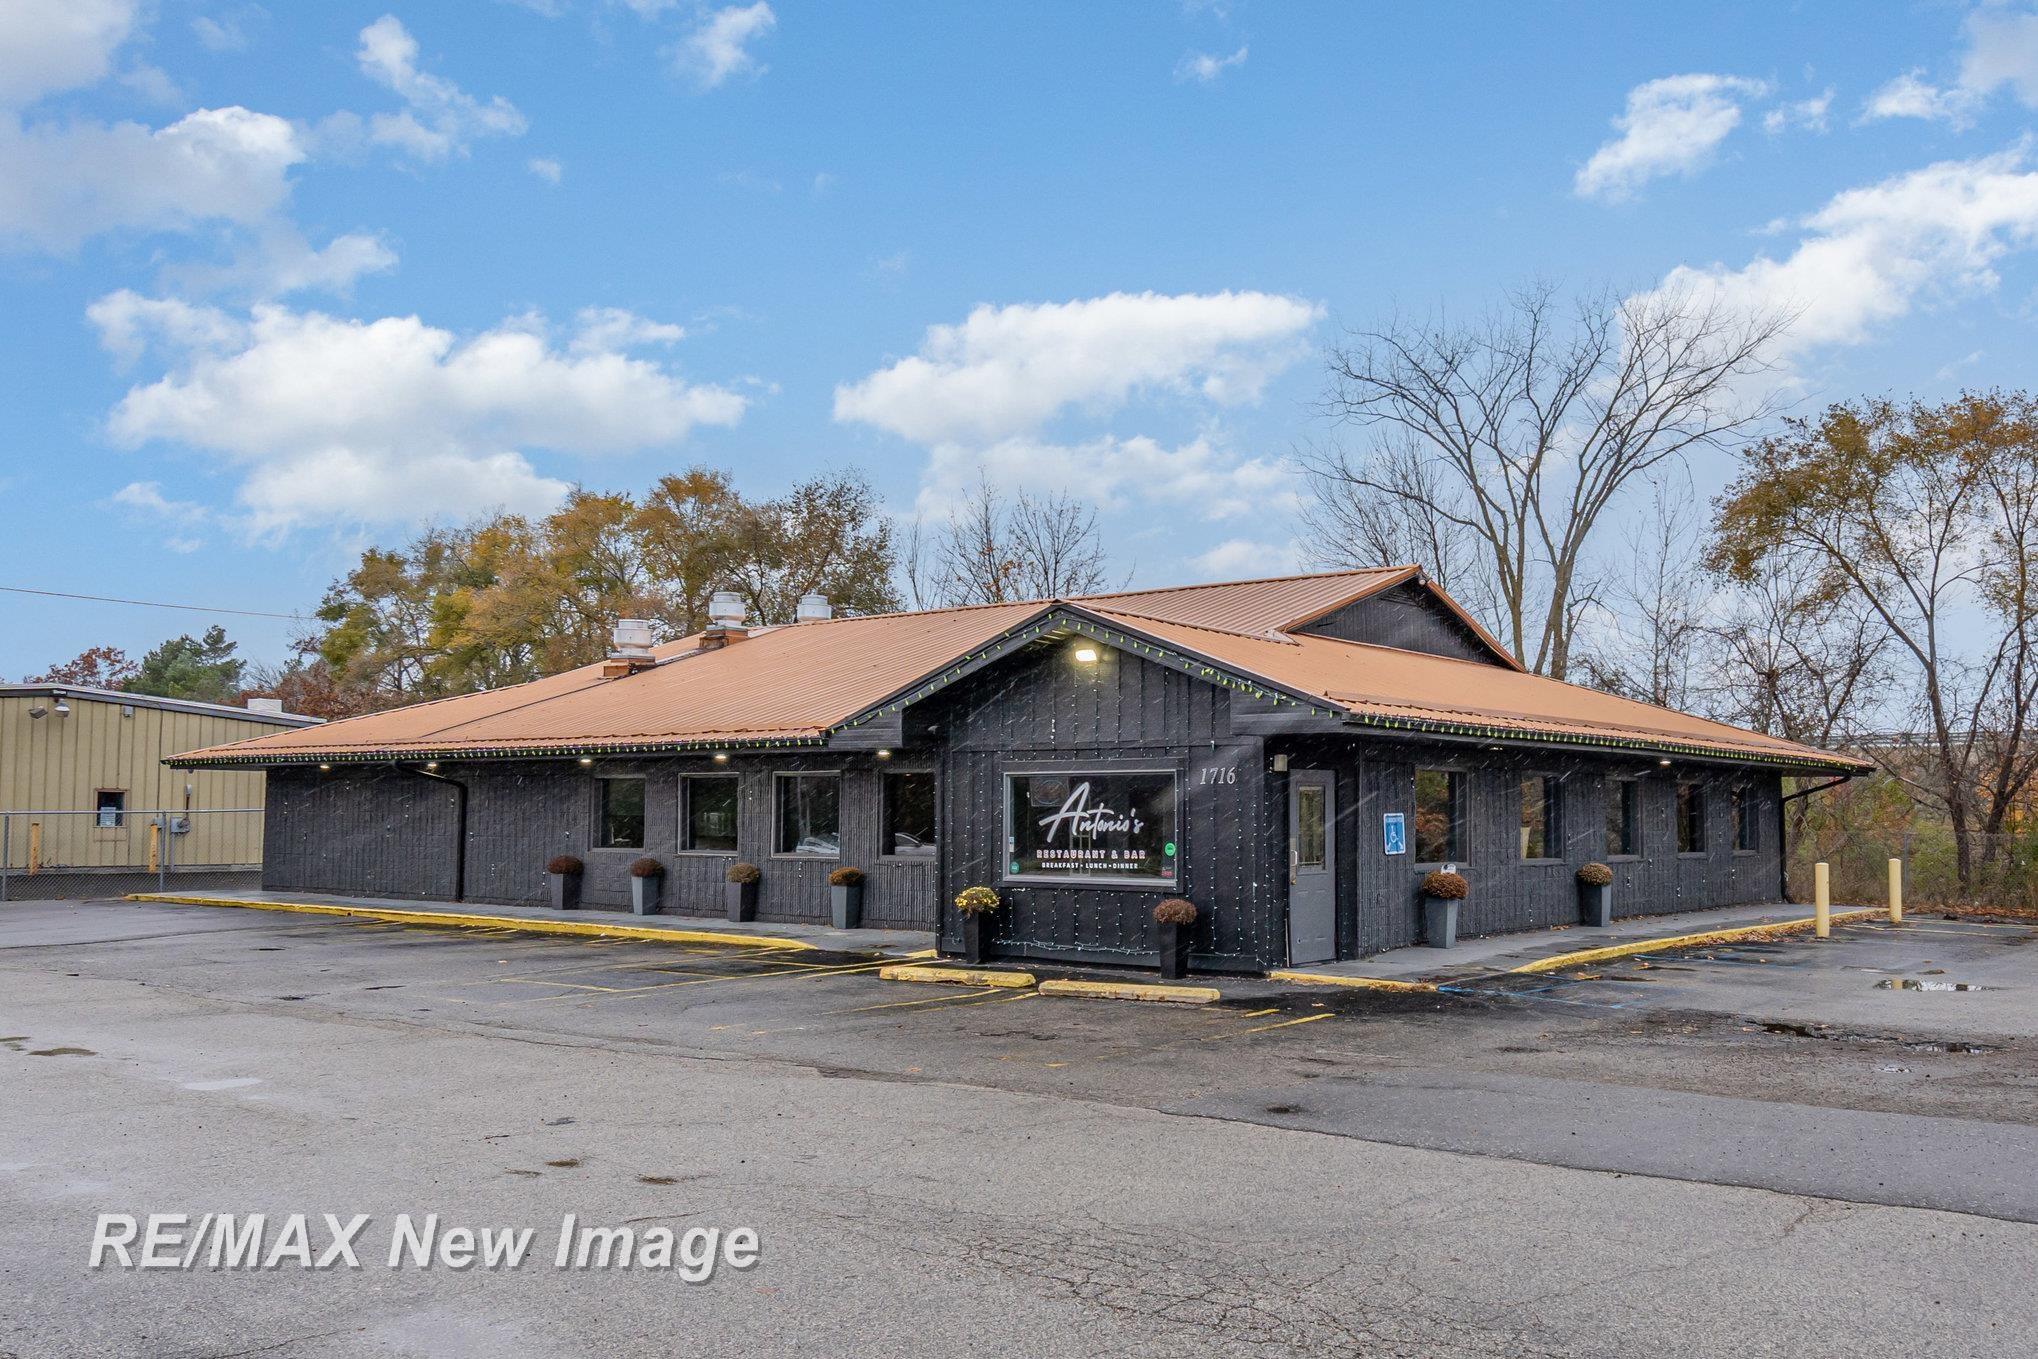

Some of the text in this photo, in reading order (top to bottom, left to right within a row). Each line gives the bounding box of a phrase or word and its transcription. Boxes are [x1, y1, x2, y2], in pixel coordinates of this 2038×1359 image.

[1200, 767, 1236, 785] 1716
[1039, 781, 1144, 843] Antonio's
[1036, 849, 1146, 859] RESTAURANT & BAR
